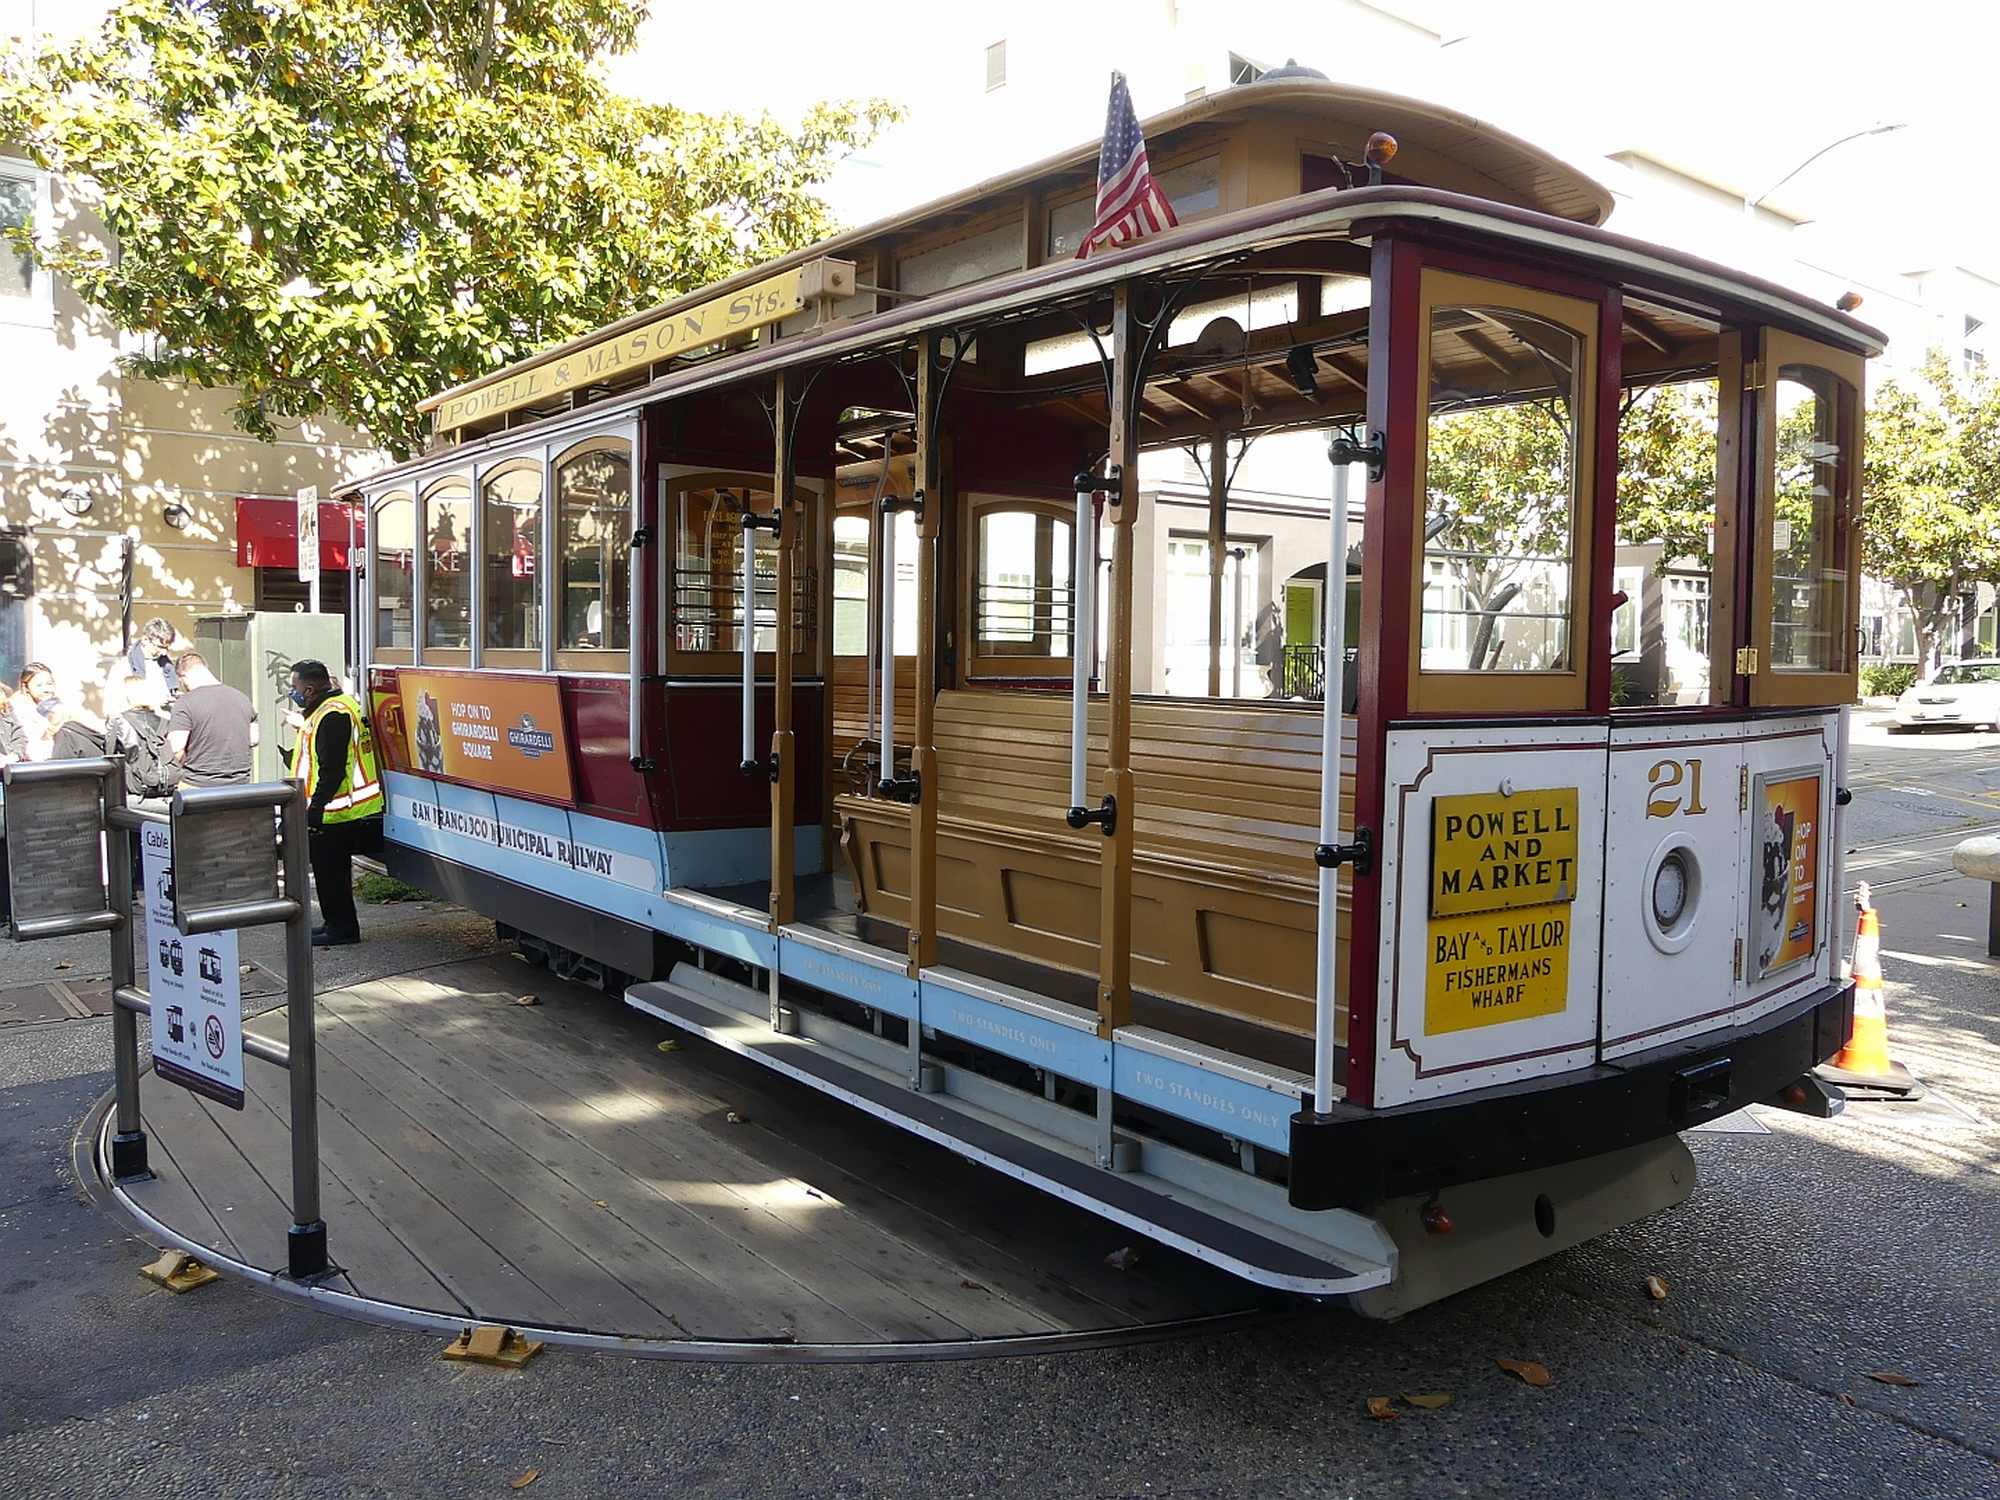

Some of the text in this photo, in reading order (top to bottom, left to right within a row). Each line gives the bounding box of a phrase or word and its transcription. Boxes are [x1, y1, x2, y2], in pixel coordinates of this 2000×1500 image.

[449, 287, 786, 423] POWELL & MASON Sts.
[450, 702, 492, 721] HOP ON TO
[452, 721, 499, 742] GHIRARDELLI
[509, 731, 553, 748] GHIRARDELLI
[463, 741, 493, 760] SQUARE
[1645, 759, 1708, 819] 21
[1445, 808, 1570, 842] POWELL
[1795, 822, 1812, 841] HOP
[146, 831, 169, 849] Cable
[412, 802, 431, 821] SAN
[557, 840, 612, 875] RAILWAY
[1480, 838, 1543, 862] AND
[1795, 844, 1807, 861] ON
[1441, 858, 1573, 895] MARKET
[1794, 864, 1805, 882] TO
[1435, 932, 1471, 964] BAY
[1498, 920, 1565, 955] TAYLOR
[1445, 958, 1551, 992] FISHERMANS
[1471, 984, 1526, 1009] WHARF
[1136, 1071, 1164, 1090] TWO
[1241, 1104, 1280, 1129] ONLY
